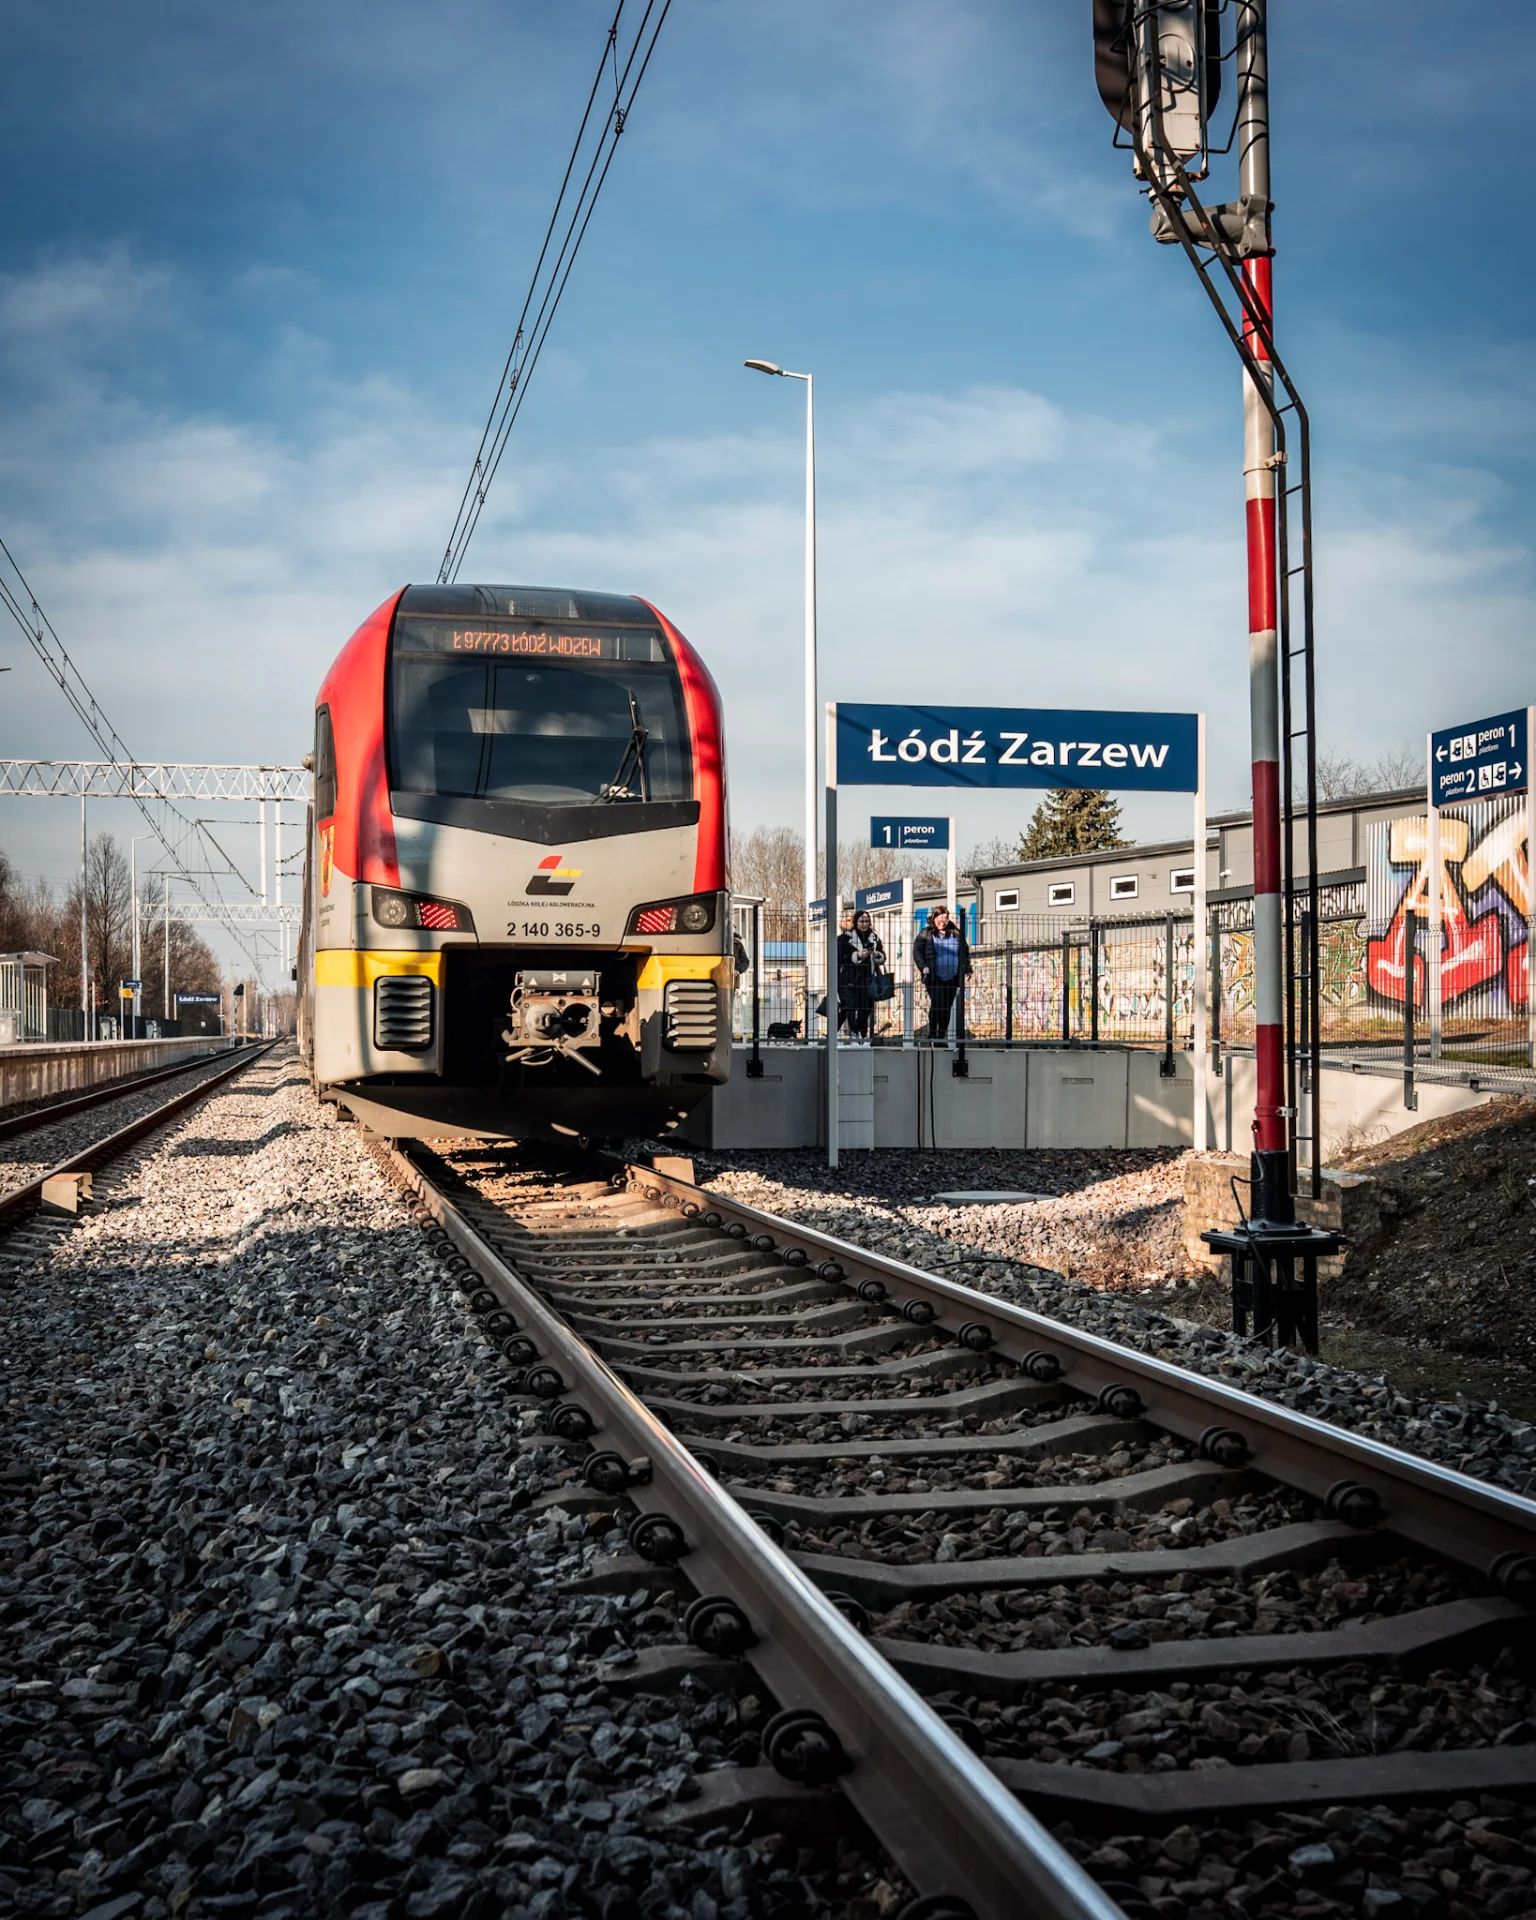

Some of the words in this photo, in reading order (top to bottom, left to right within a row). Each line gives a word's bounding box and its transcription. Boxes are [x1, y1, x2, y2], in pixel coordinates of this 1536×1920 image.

[453, 631, 462, 649] Ł
[464, 632, 509, 651] 97773
[512, 632, 546, 653] ŁÓDŹ
[549, 636, 601, 656] WIDZEW
[1478, 726, 1505, 746] peron
[1508, 724, 1516, 748] 1
[867, 729, 986, 764] Łódź
[998, 732, 1170, 768] Zarzew
[1440, 771, 1465, 790] peron
[1465, 768, 1476, 793] 2
[882, 825, 891, 844] 1
[904, 825, 935, 835] peron
[506, 922, 516, 936] 2
[521, 922, 549, 937] 140
[555, 923, 601, 937] 365-9
